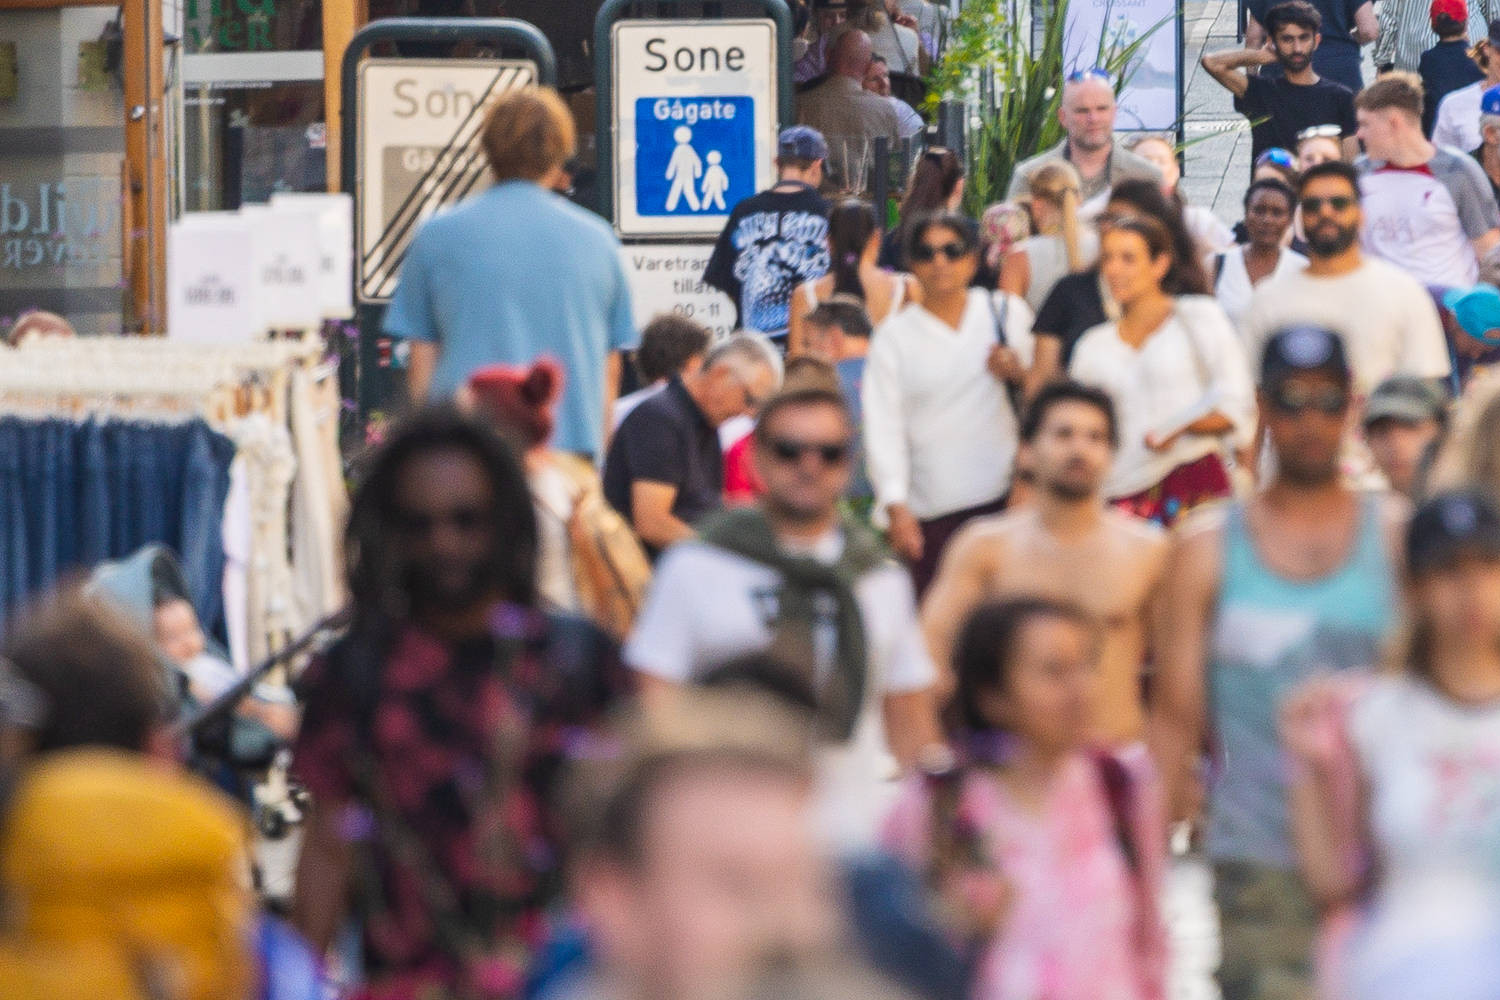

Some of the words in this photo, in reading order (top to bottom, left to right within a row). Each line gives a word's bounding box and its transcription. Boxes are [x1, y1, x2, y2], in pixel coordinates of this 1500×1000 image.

[645, 38, 745, 72] Sone
[393, 78, 476, 119] Son
[653, 99, 736, 125] Gågate
[632, 256, 709, 271] Varetran
[673, 279, 714, 294] tilla
